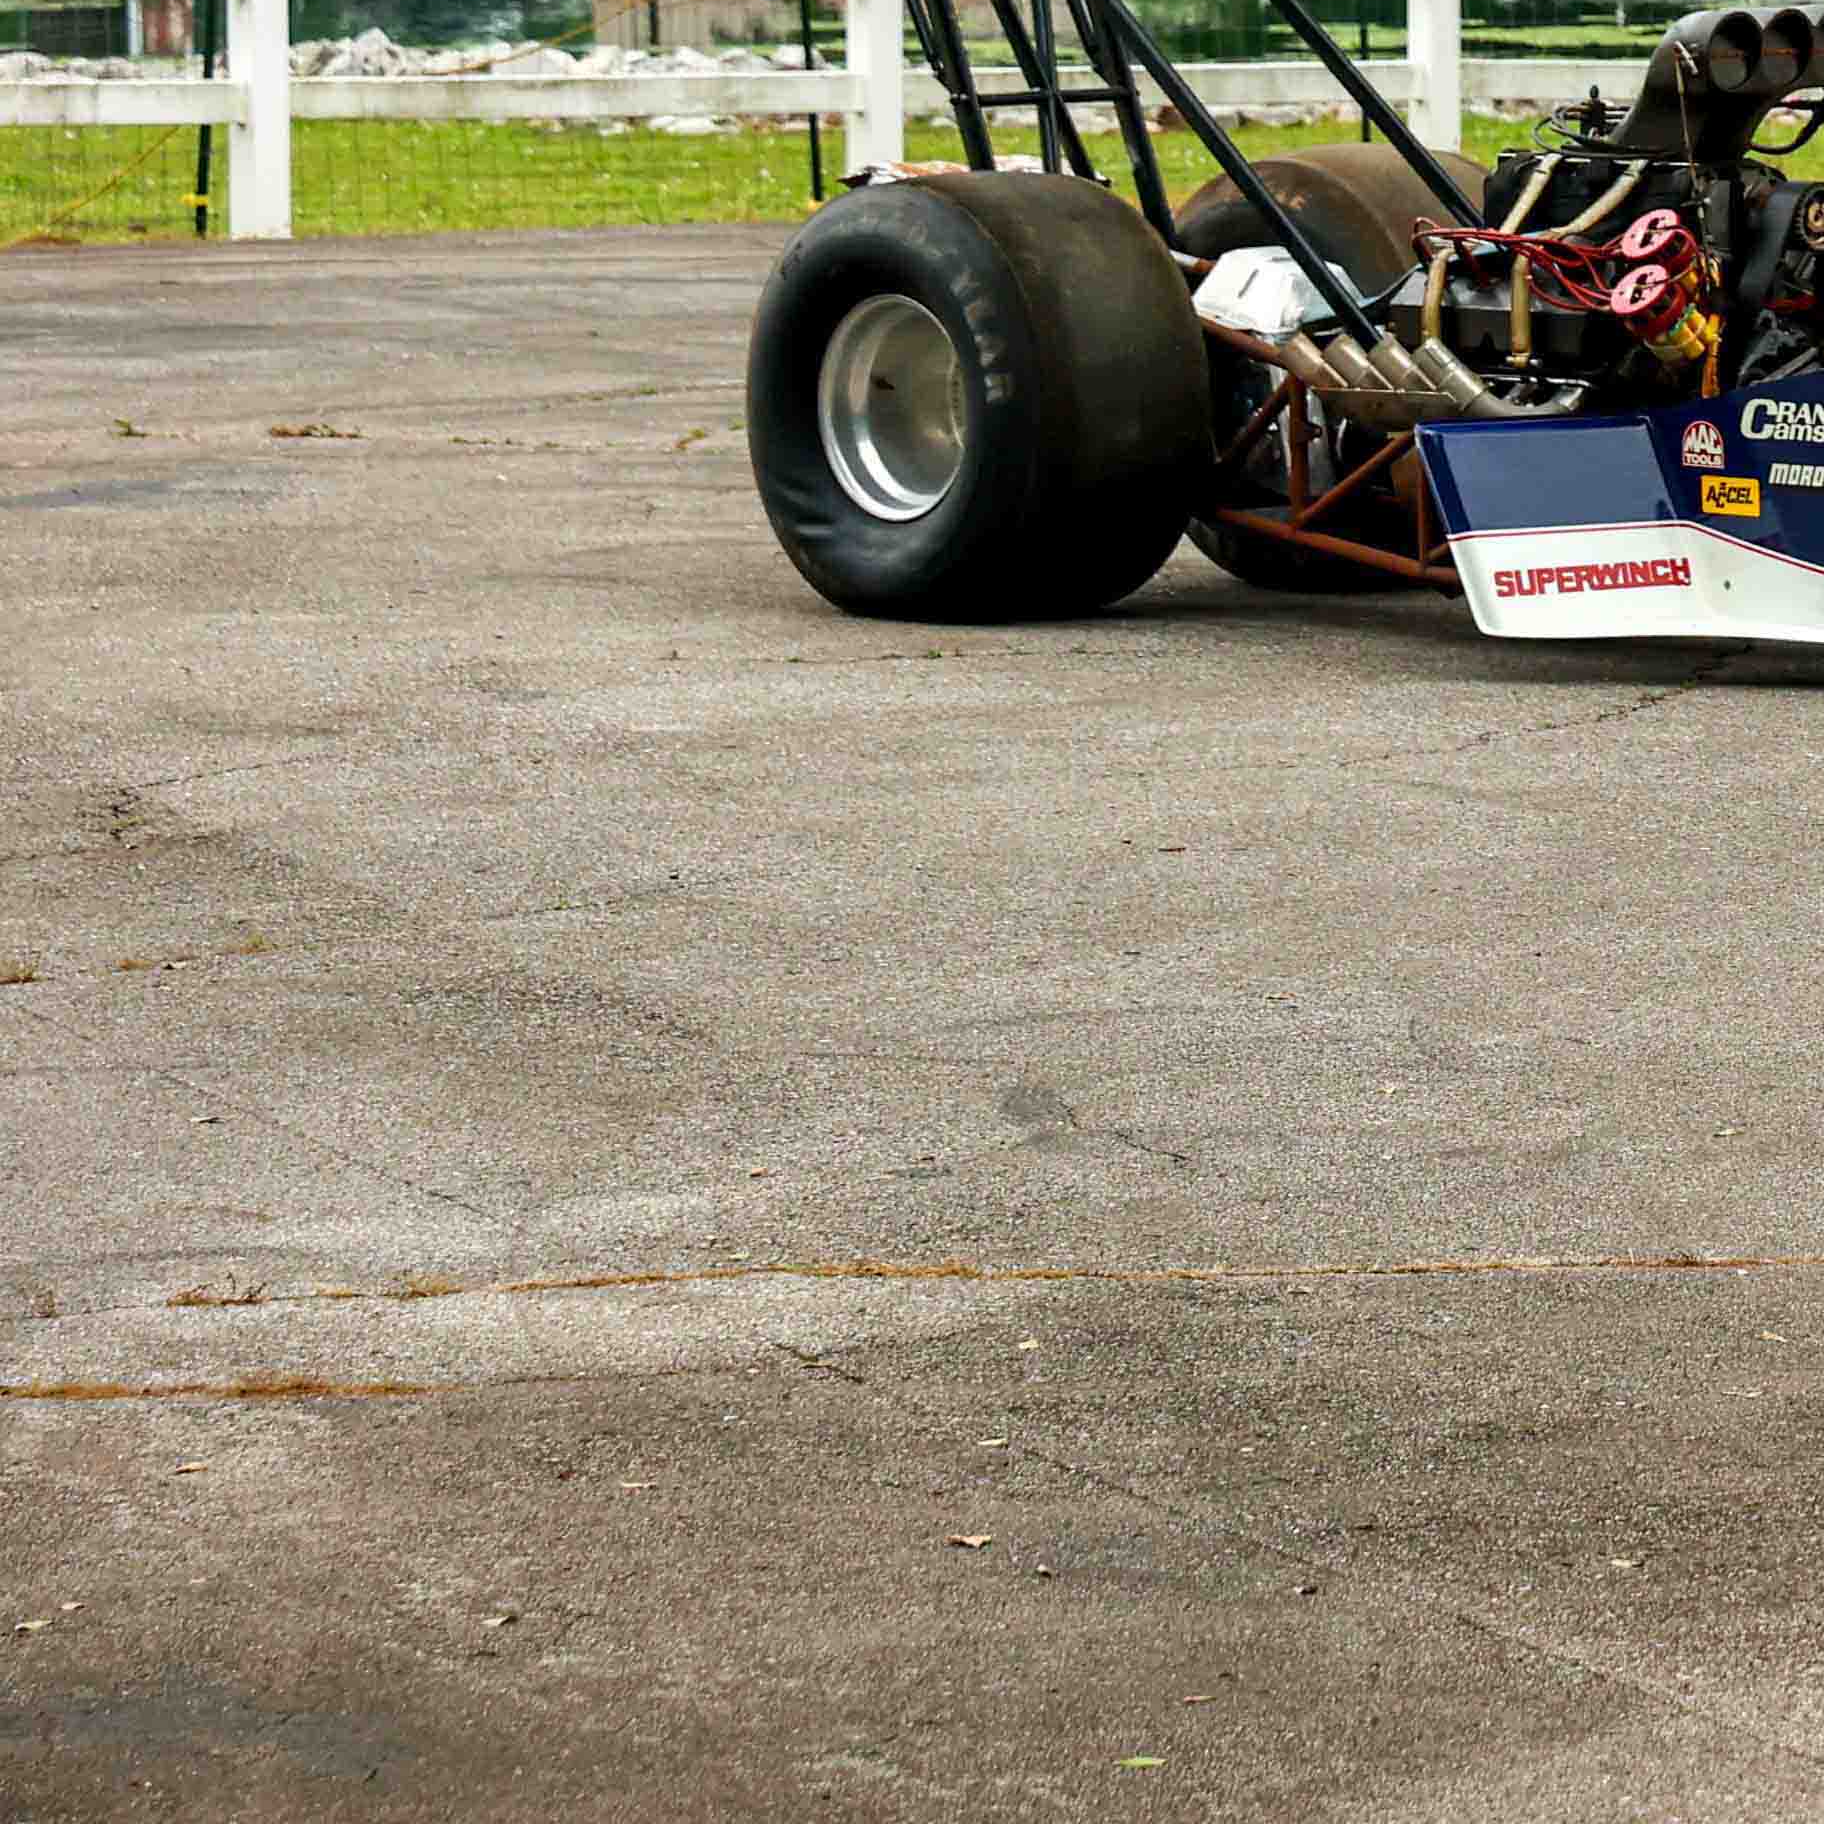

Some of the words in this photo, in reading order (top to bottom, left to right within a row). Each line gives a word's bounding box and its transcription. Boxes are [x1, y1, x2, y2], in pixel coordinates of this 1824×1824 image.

[1683, 424, 1723, 454] MAC
[1684, 453, 1722, 467] TOOLS
[1494, 557, 1692, 598] SUPERWINCH
